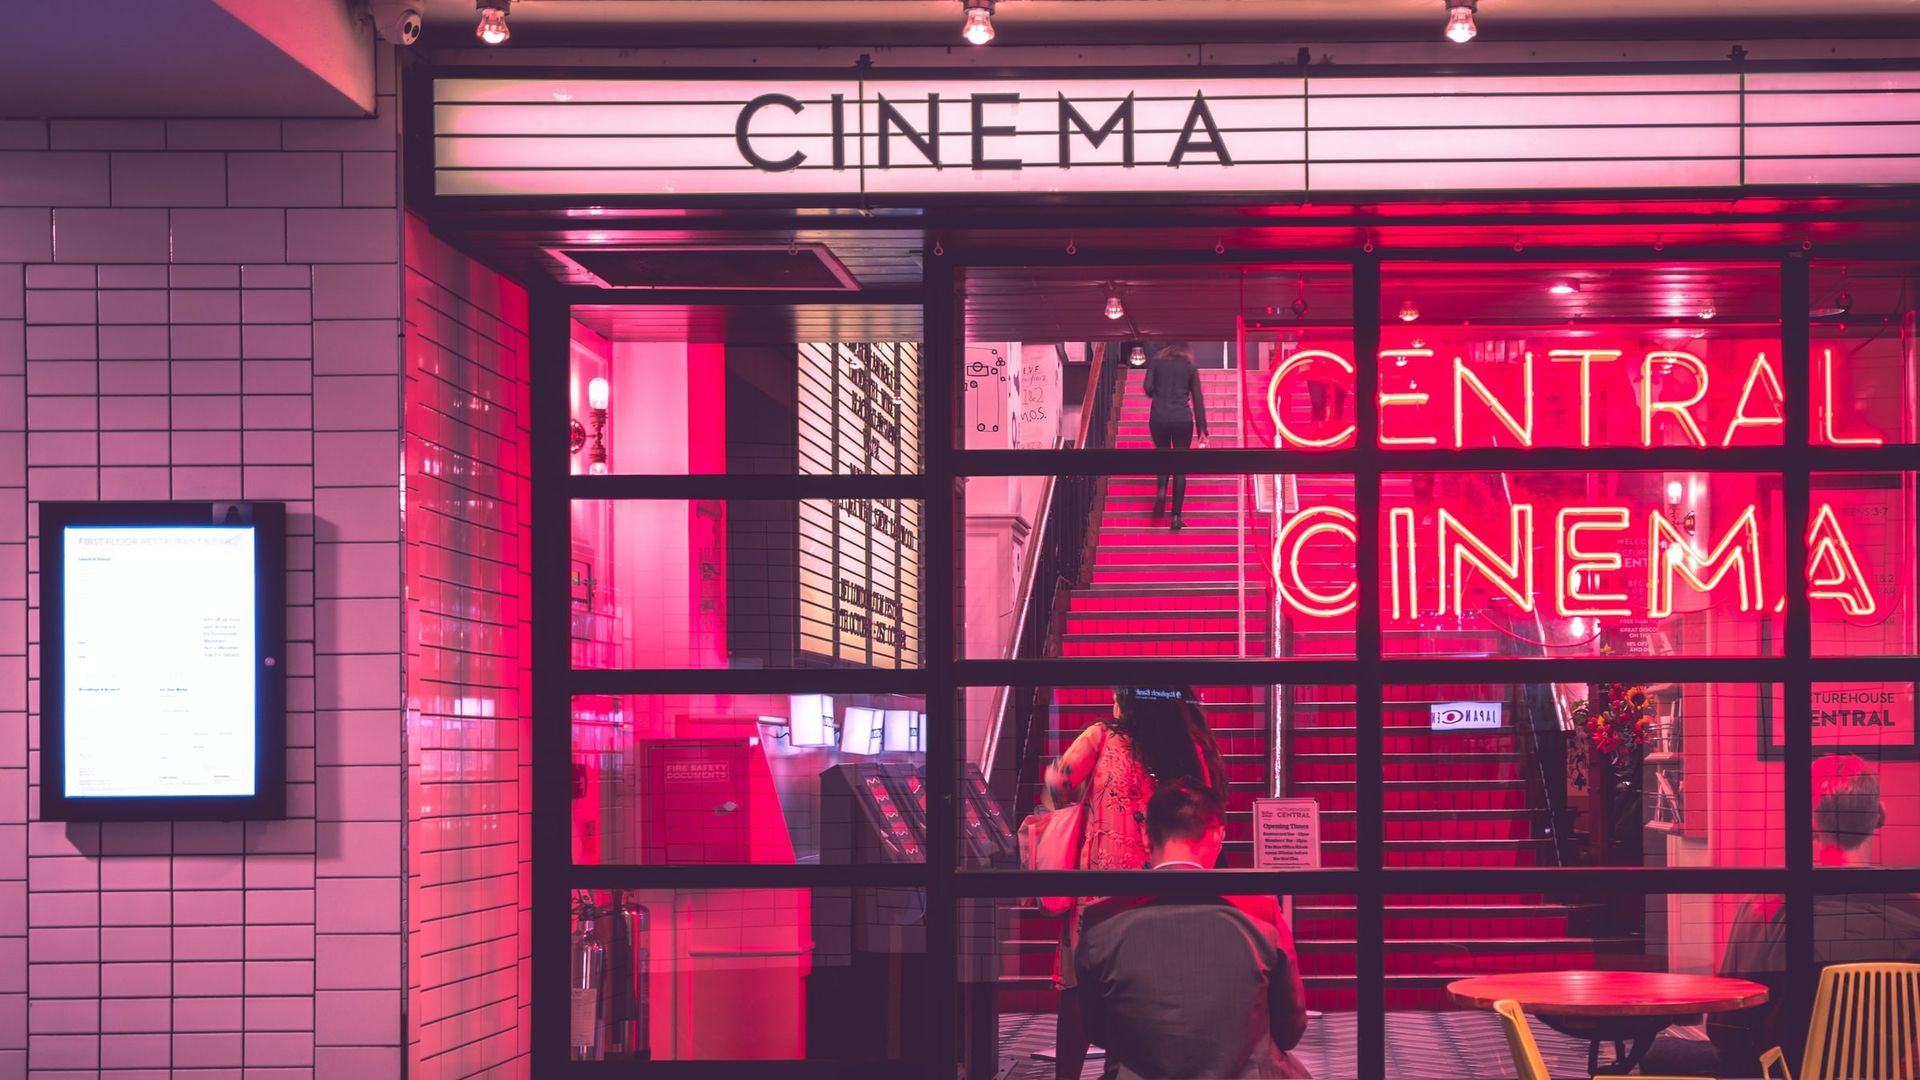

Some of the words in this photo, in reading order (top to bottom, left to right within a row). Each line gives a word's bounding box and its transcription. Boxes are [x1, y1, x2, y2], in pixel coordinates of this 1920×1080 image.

[735, 88, 1234, 172] CINEMA
[1268, 349, 1883, 447] CENTRAL
[1273, 504, 1876, 619] CINEMA
[1624, 557, 1649, 568] ENT
[1813, 692, 1896, 704] TUREHOUSE
[1811, 709, 1896, 727] ENTRAL
[666, 764, 688, 772] FIRE
[690, 763, 728, 772] SAFETY
